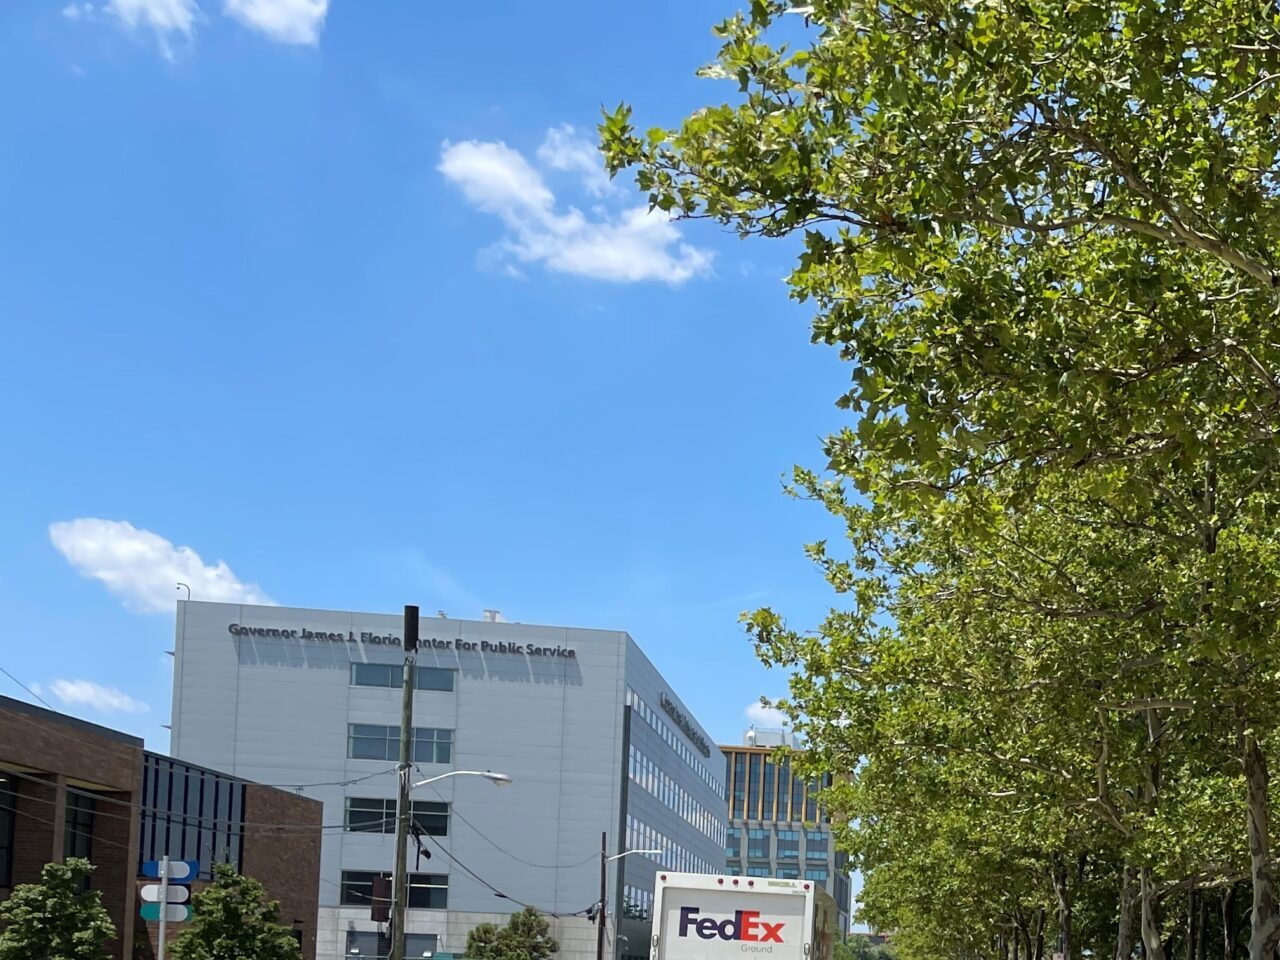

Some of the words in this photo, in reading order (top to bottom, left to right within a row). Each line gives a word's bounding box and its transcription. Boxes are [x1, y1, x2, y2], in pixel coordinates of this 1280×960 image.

[228, 623, 297, 640] Governor
[299, 628, 343, 643] James
[360, 631, 402, 646] Florio
[416, 637, 453, 649] enter
[455, 638, 478, 651] For
[481, 640, 524, 655] Public
[526, 643, 577, 659] Service
[678, 906, 786, 943] FedEx
[740, 943, 773, 954] Ground
